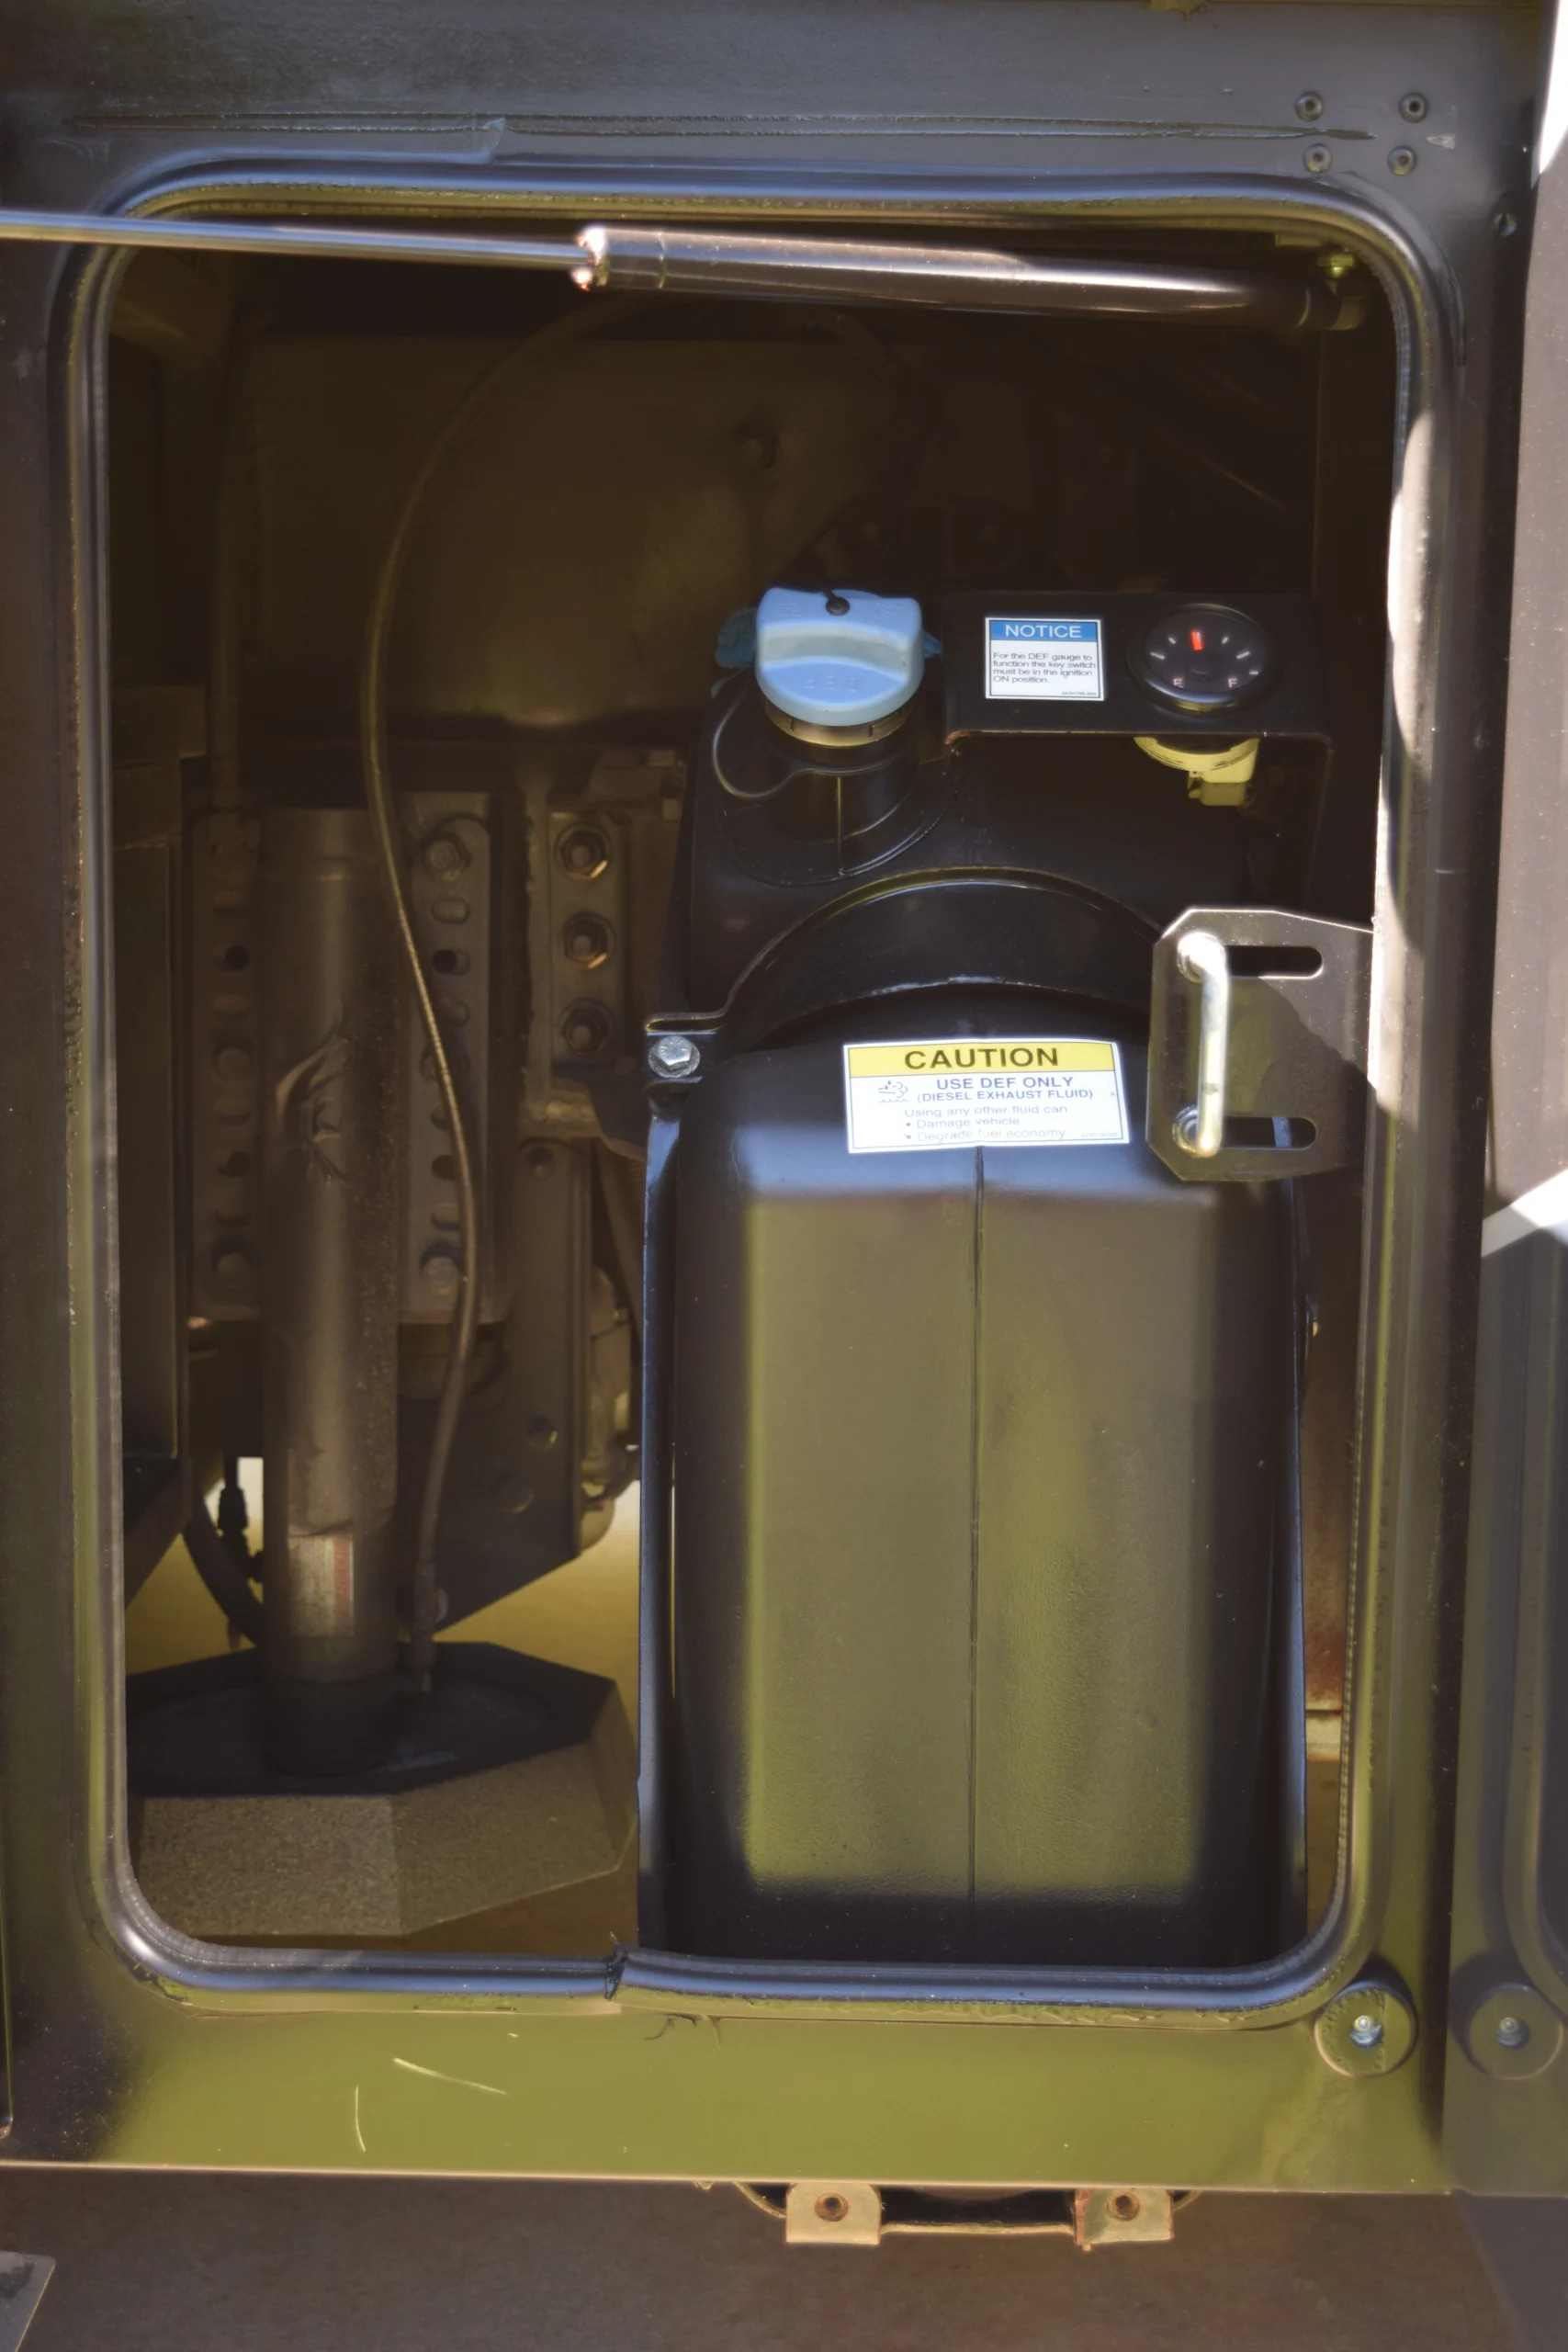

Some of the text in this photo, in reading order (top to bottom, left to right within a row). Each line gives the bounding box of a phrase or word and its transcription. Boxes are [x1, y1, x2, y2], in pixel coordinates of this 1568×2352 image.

[1005, 625, 1082, 639] NOTICE
[1060, 670, 1093, 678] ignition
[1174, 678, 1184, 688] E
[1228, 678, 1238, 688] F
[905, 1047, 1058, 1069] CAUTION
[936, 1076, 1074, 1091] USE DEF ONLY
[917, 1089, 1093, 1103] (DIESEL EXHAUST FLUID)
[904, 1104, 1067, 1119] Using any other fluid can
[917, 1116, 1021, 1130] Damage vehicle
[918, 1128, 1066, 1143] Degrade fuel economy
